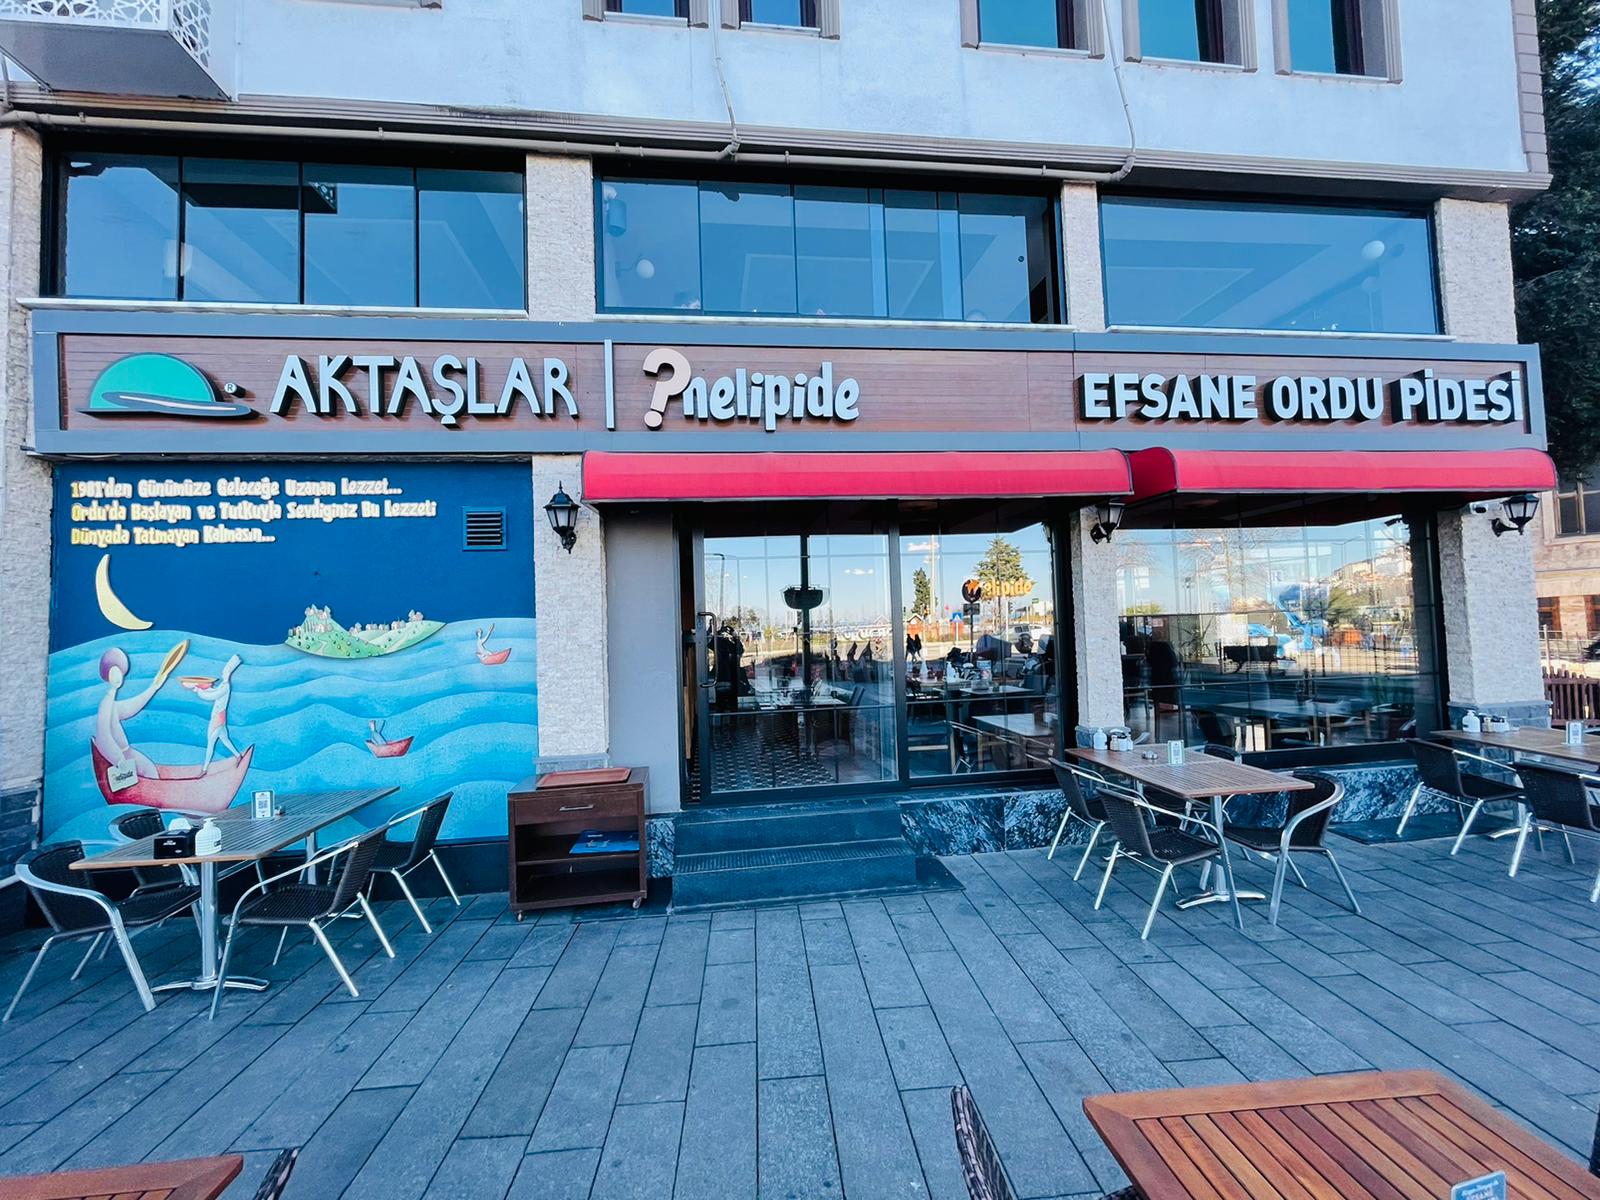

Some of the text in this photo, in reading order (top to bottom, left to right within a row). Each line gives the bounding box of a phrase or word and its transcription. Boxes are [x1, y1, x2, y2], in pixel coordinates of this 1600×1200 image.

[270, 355, 578, 424] AKTAŞLAR
[1083, 368, 1524, 421] EFSANE ORDU PİDESİ
[138, 480, 211, 497] Günümüze
[217, 477, 279, 499] Geleceğe
[286, 480, 335, 496] Uzanan
[72, 500, 126, 521] Ordu'da
[131, 501, 191, 523] Başlayan
[197, 505, 215, 519] ve
[362, 501, 379, 517] Bu
[385, 500, 436, 516] Lezzeti
[72, 524, 130, 547] Dünyada
[133, 526, 199, 546] Tatmayan
